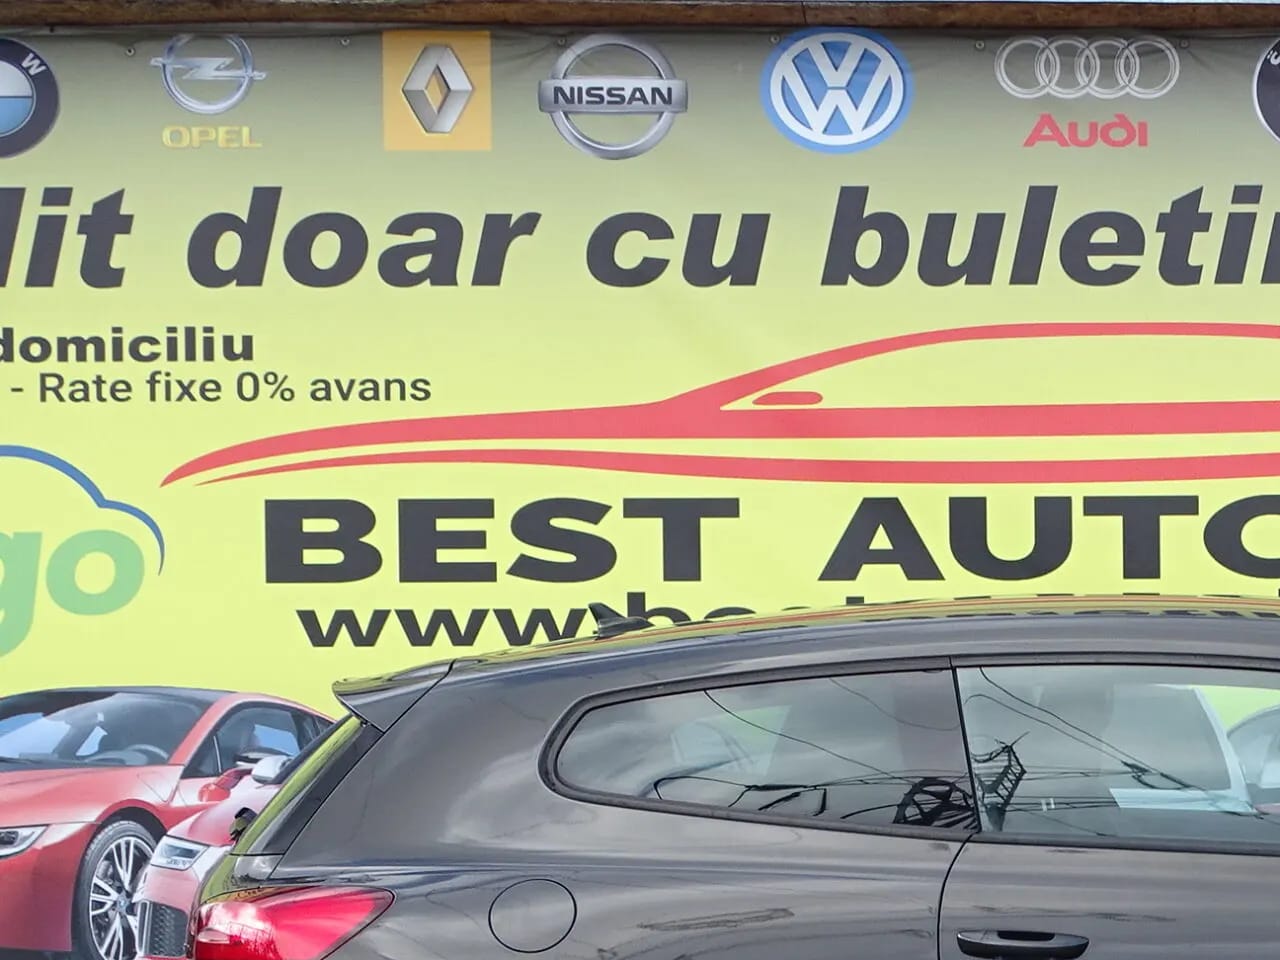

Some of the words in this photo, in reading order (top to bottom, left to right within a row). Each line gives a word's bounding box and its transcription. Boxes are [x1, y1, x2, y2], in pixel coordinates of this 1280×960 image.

[554, 86, 673, 107] NISSAN
[161, 125, 262, 150] OPEL
[1023, 112, 1149, 148] Audi
[188, 186, 542, 288] doar
[587, 212, 771, 288] cu
[39, 373, 133, 402] Rate
[145, 371, 222, 402] fixe
[236, 371, 295, 402] 0%
[310, 378, 432, 402] avans
[264, 498, 740, 584] BEST
